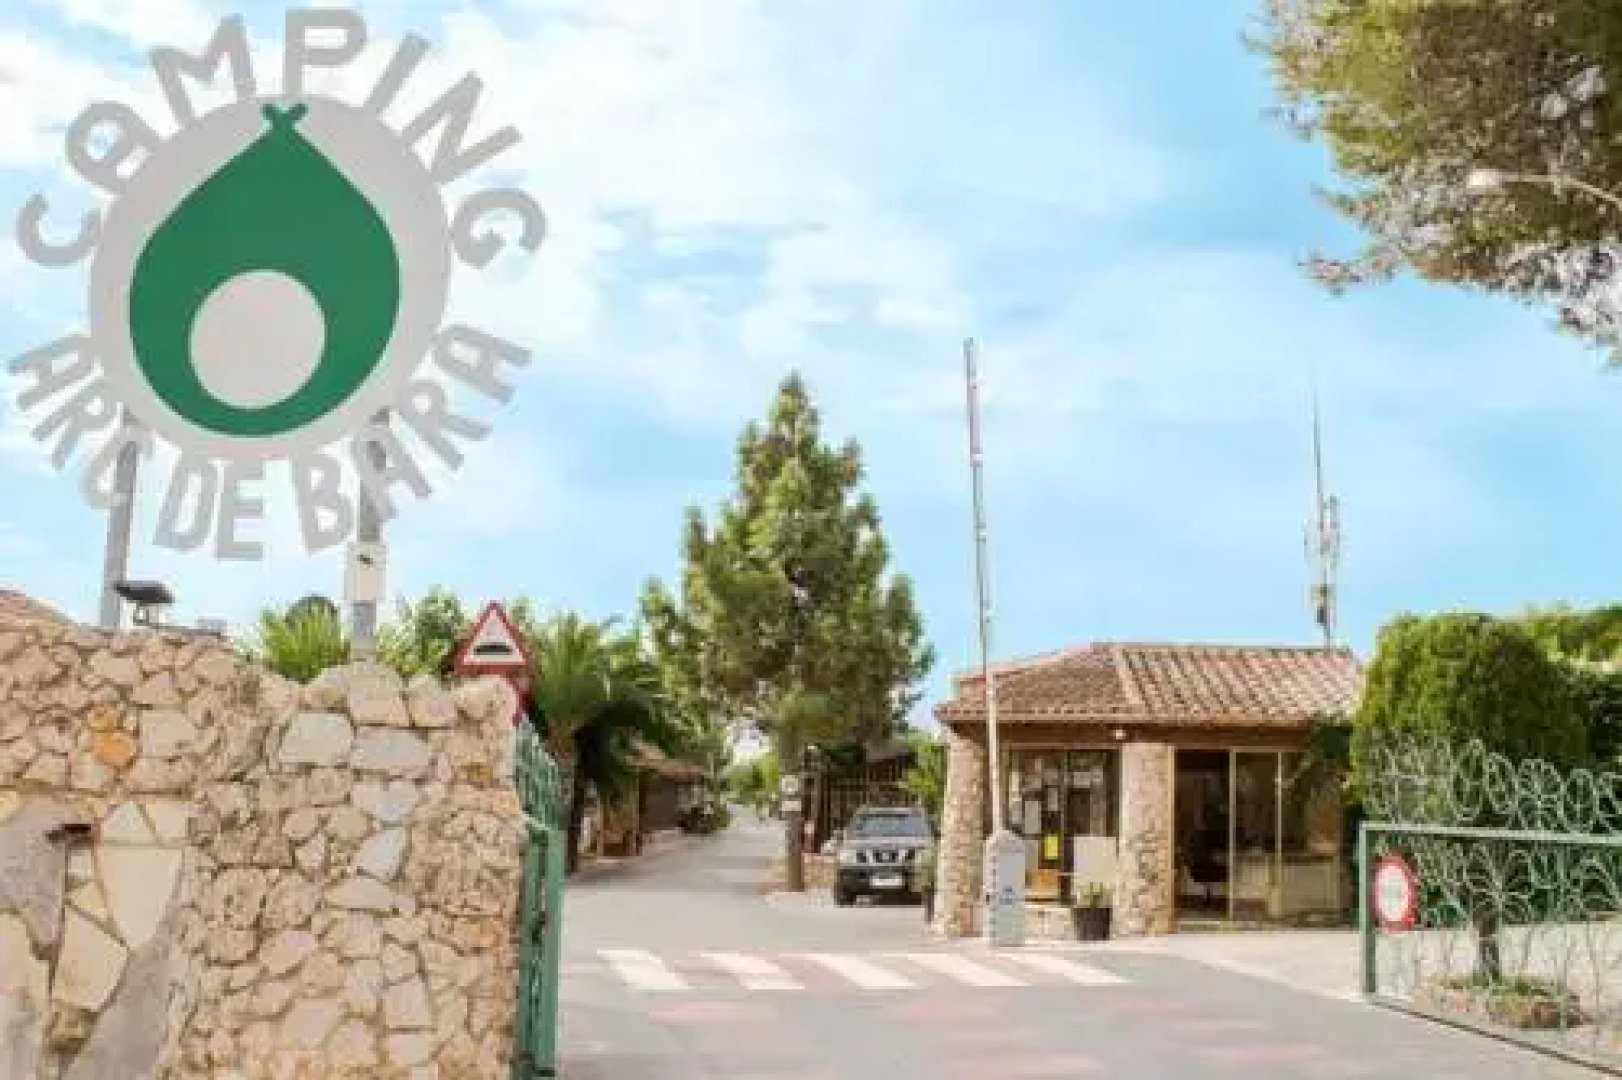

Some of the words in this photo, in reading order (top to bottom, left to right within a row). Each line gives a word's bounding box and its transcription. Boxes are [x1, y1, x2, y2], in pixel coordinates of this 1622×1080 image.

[15, 8, 547, 268] CAMPING
[9, 328, 154, 510] ARC
[152, 446, 264, 561] DE
[290, 323, 532, 555] BARA
